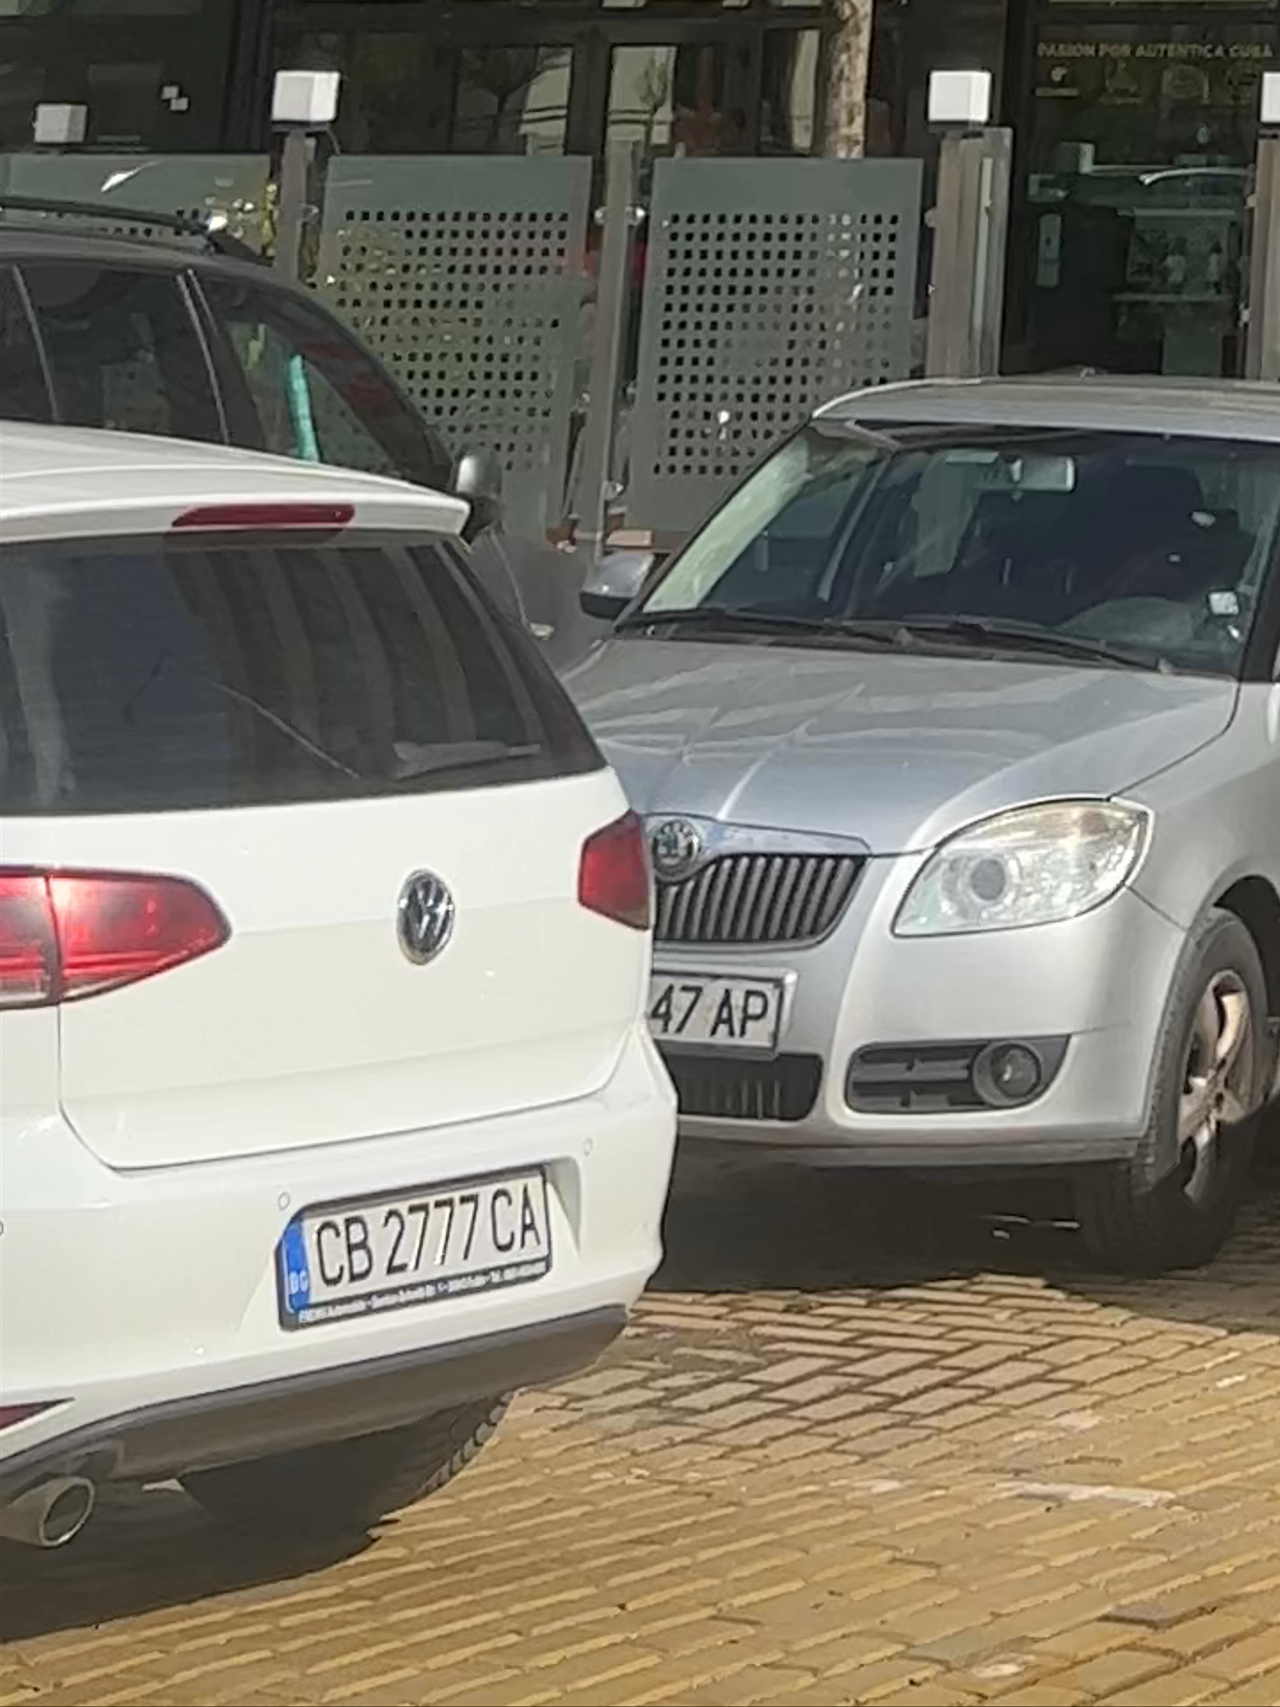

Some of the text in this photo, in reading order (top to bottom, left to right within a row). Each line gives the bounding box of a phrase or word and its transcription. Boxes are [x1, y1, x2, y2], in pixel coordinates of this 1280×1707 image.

[1098, 42, 1132, 58] POR
[709, 988, 769, 1038] AP
[315, 1182, 542, 1287] CB 2777 CA
